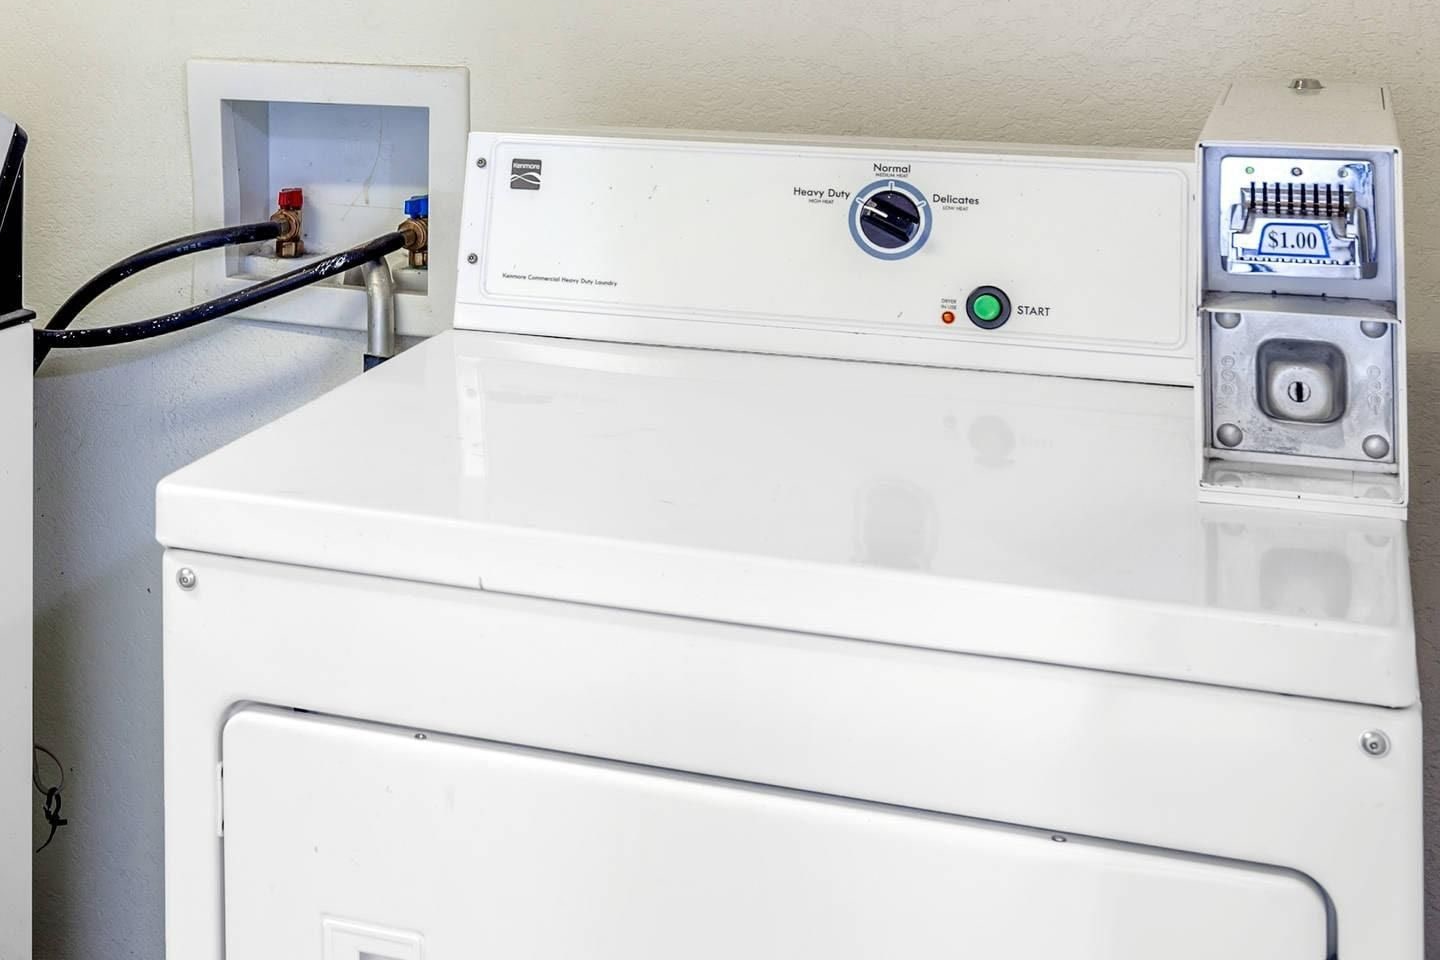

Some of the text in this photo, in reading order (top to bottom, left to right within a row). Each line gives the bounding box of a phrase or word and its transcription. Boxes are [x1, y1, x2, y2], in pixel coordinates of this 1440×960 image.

[873, 163, 911, 173] Normal
[793, 186, 850, 200] Heavy Duty
[932, 193, 980, 205] Delicates
[1268, 229, 1318, 250] $1.00
[502, 272, 617, 287] Kenmore Commercial Heavy Duty Laundry
[1017, 305, 1051, 316] START
